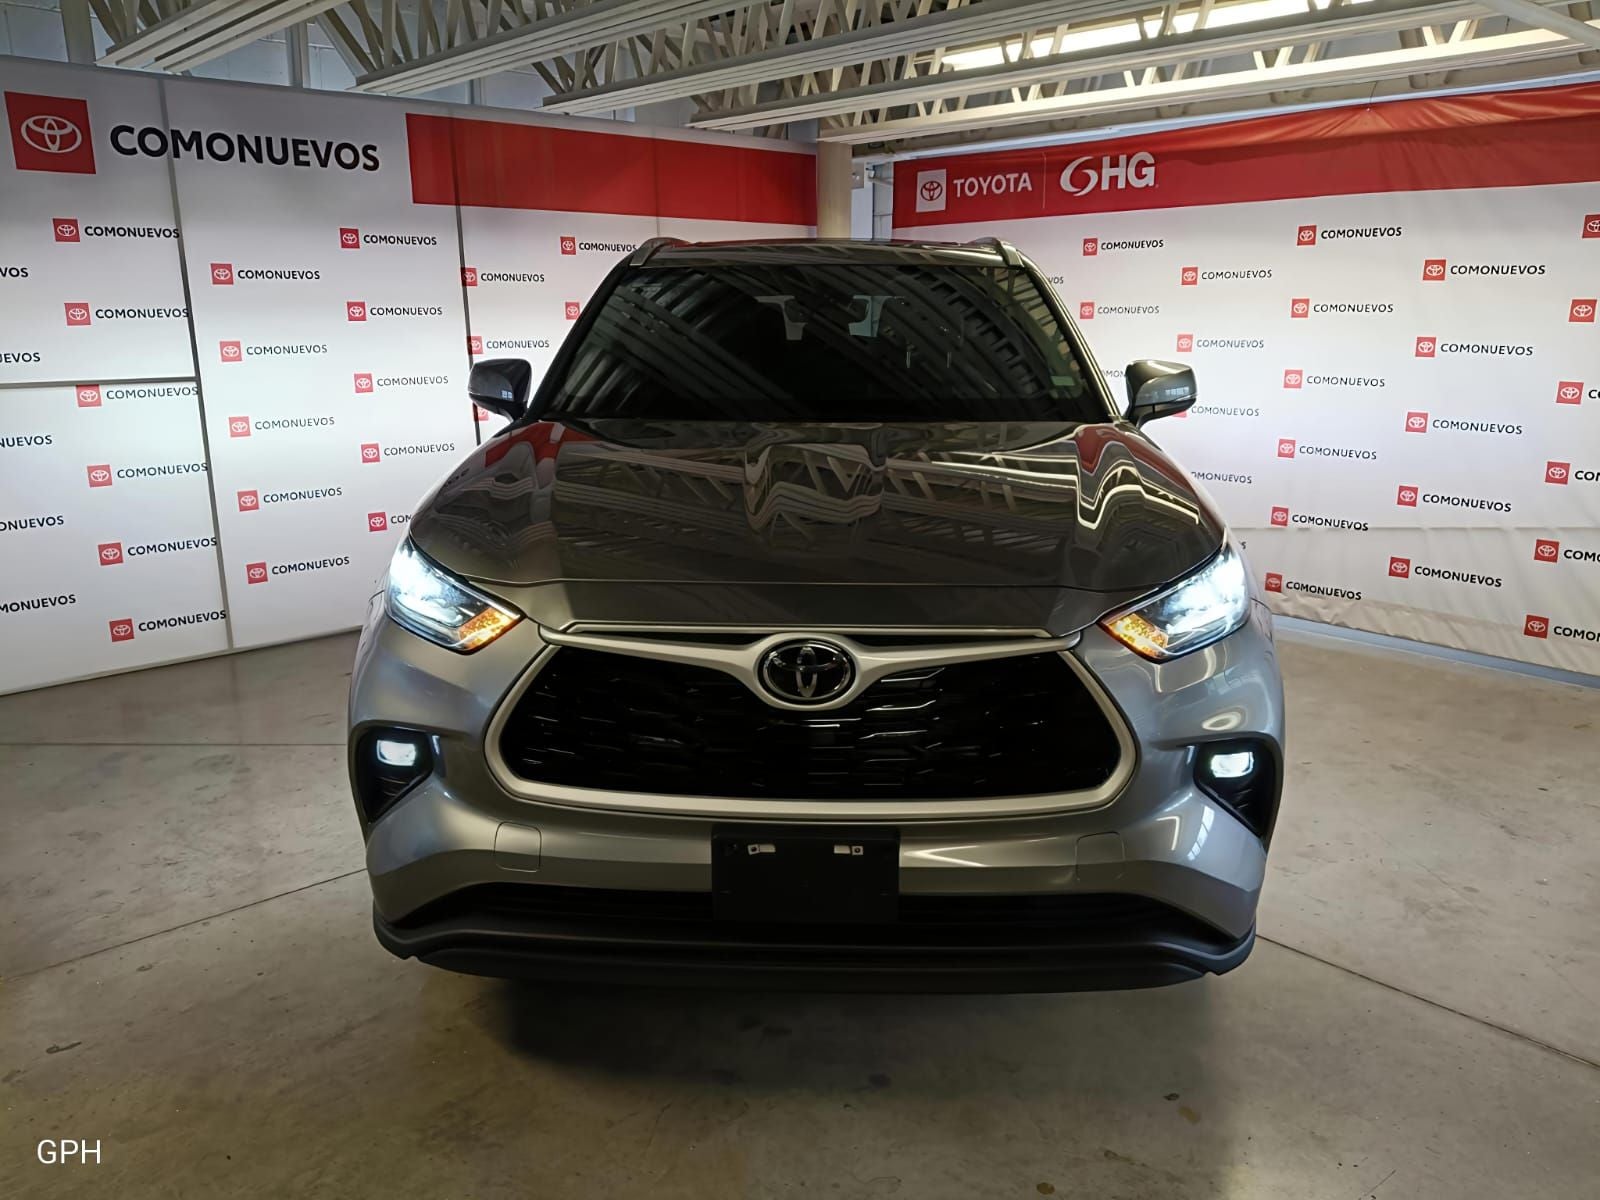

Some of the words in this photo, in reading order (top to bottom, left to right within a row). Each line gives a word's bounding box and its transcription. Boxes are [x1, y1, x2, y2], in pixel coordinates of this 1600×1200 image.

[110, 125, 380, 172] COMONUEVOS
[953, 172, 1033, 198] TOYOTA
[84, 226, 180, 239] COMONUEVOS
[1320, 226, 1402, 240] COMONUEVOS
[363, 234, 437, 246] COMONUEVOS
[1100, 239, 1164, 251] COMONUEVOS
[237, 269, 321, 280] COMONUEVOS
[1201, 269, 1273, 280] COMONUEVOS
[1450, 264, 1546, 275] COMONUEVOS
[480, 272, 545, 283] COMONUEVOS
[95, 308, 189, 319] COMONUEVOS
[369, 306, 443, 316] COMONUEVOS
[1097, 305, 1160, 314] COMONUEVOS
[1313, 303, 1394, 313] COMONUEVOS
[246, 344, 328, 356] COMONUEVOS
[486, 340, 550, 349] COMONUEVOS
[1196, 339, 1264, 349] COMONUEVOS
[1440, 343, 1534, 356] COMONUEVOS
[376, 375, 449, 387] COMONUEVOS
[1306, 375, 1386, 388] COMONUEVOS
[106, 386, 199, 400] COMONUEVOS
[1191, 406, 1260, 416] COMONUEVOS
[254, 416, 335, 431] COMONUEVOS
[1432, 419, 1523, 435] COMONUEVOS
[383, 442, 455, 457] COMONUEVOS
[1299, 445, 1377, 460] COMONUEVOS
[117, 462, 208, 479] COMONUEVOS
[263, 487, 343, 504] COMONUEVOS
[1422, 493, 1512, 513] COMONUEVOS
[1291, 514, 1369, 532] COMONUEVOS
[127, 537, 218, 557] COMONUEVOS
[271, 556, 350, 575] COMONUEVOS
[1414, 565, 1502, 588] COMONUEVOS
[1285, 581, 1362, 601] COMONUEVOS
[138, 610, 227, 632] COMONUEVOS
